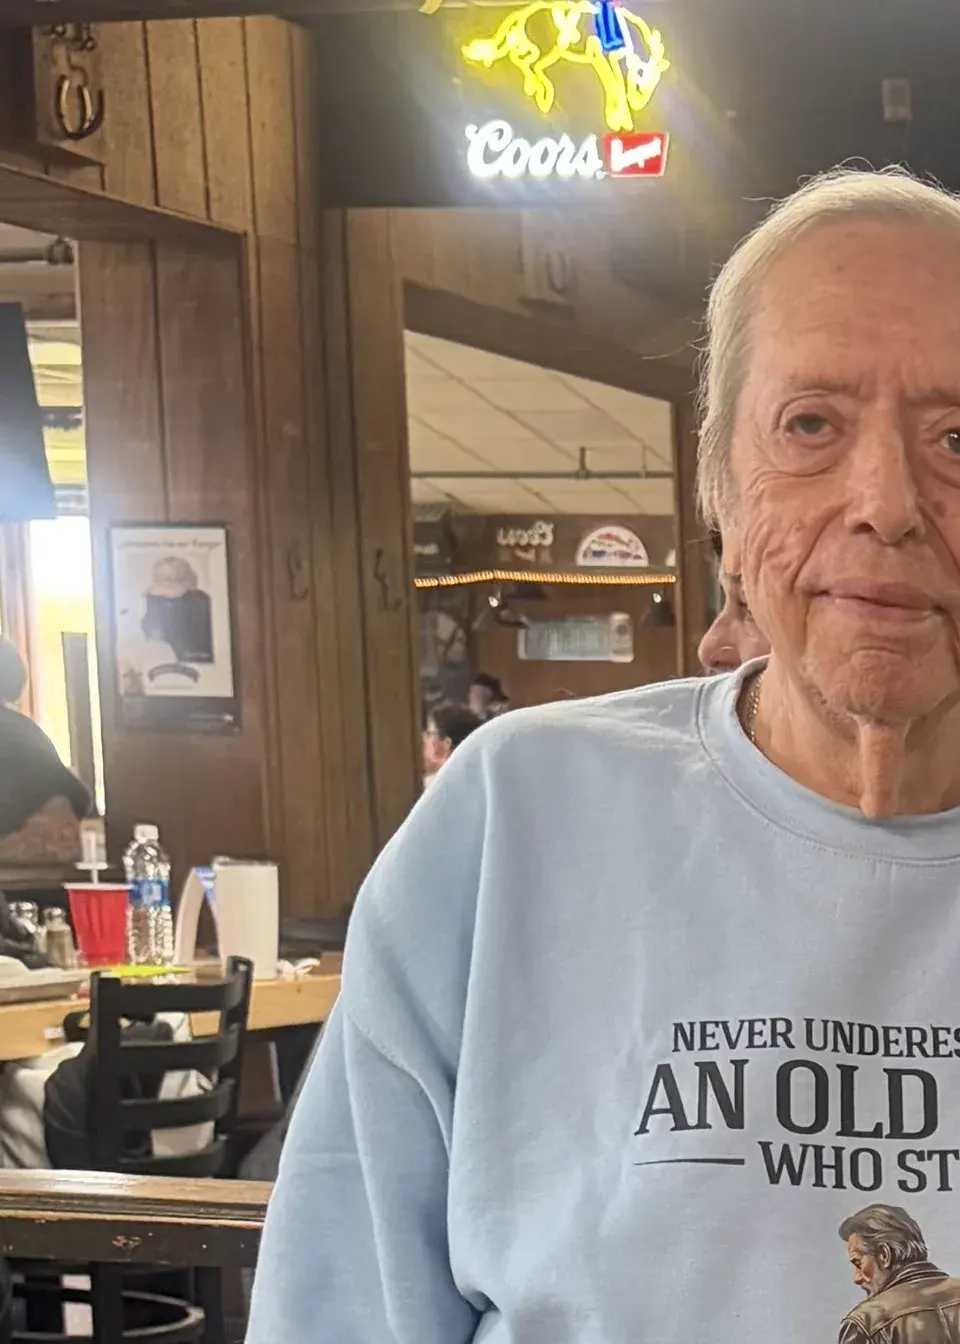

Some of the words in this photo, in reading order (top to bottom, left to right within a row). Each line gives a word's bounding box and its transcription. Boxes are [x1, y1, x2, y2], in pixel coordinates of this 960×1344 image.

[465, 119, 604, 179] Coors
[671, 1017, 796, 1053] NEVER
[634, 1058, 747, 1136] AN
[775, 1059, 939, 1140] OLD
[757, 1140, 883, 1192] WHO
